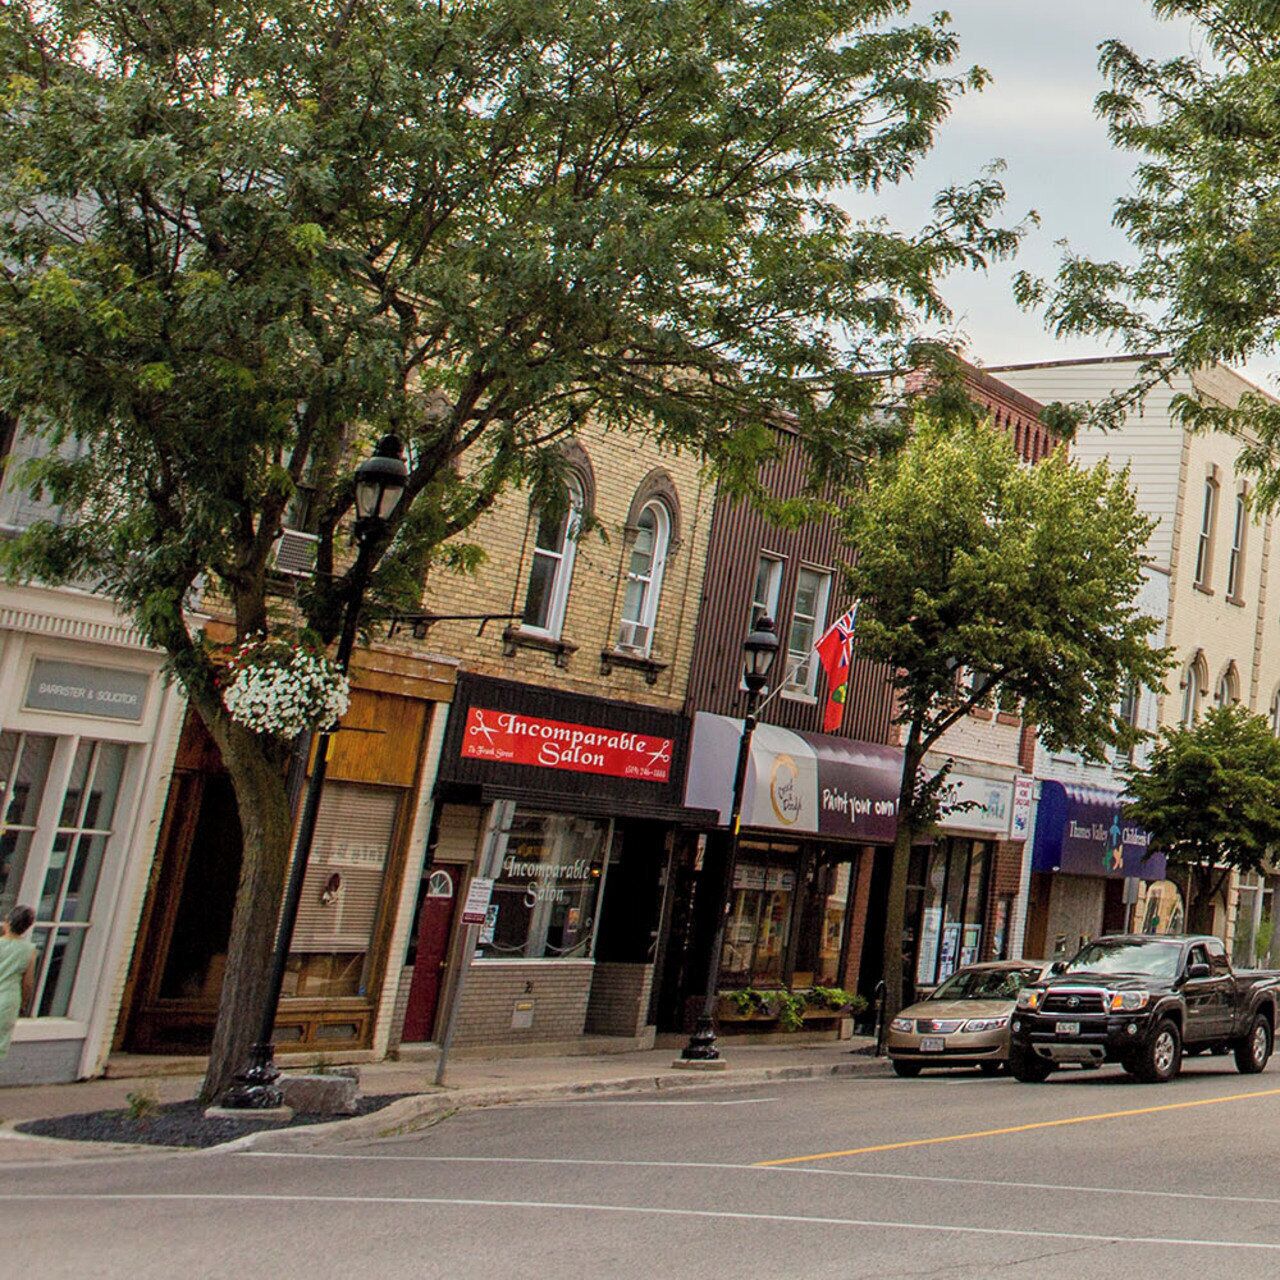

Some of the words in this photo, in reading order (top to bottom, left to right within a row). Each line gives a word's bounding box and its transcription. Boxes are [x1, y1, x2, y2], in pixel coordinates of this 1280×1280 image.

[498, 713, 646, 752] Incomparable
[538, 741, 605, 766] Salon
[822, 787, 848, 814] Paint
[850, 797, 871, 823] your
[874, 800, 894, 817] own
[1070, 821, 1091, 840] Thames
[1092, 823, 1108, 847] Valley
[503, 855, 591, 884] Incomparable
[524, 881, 564, 908] Salon
